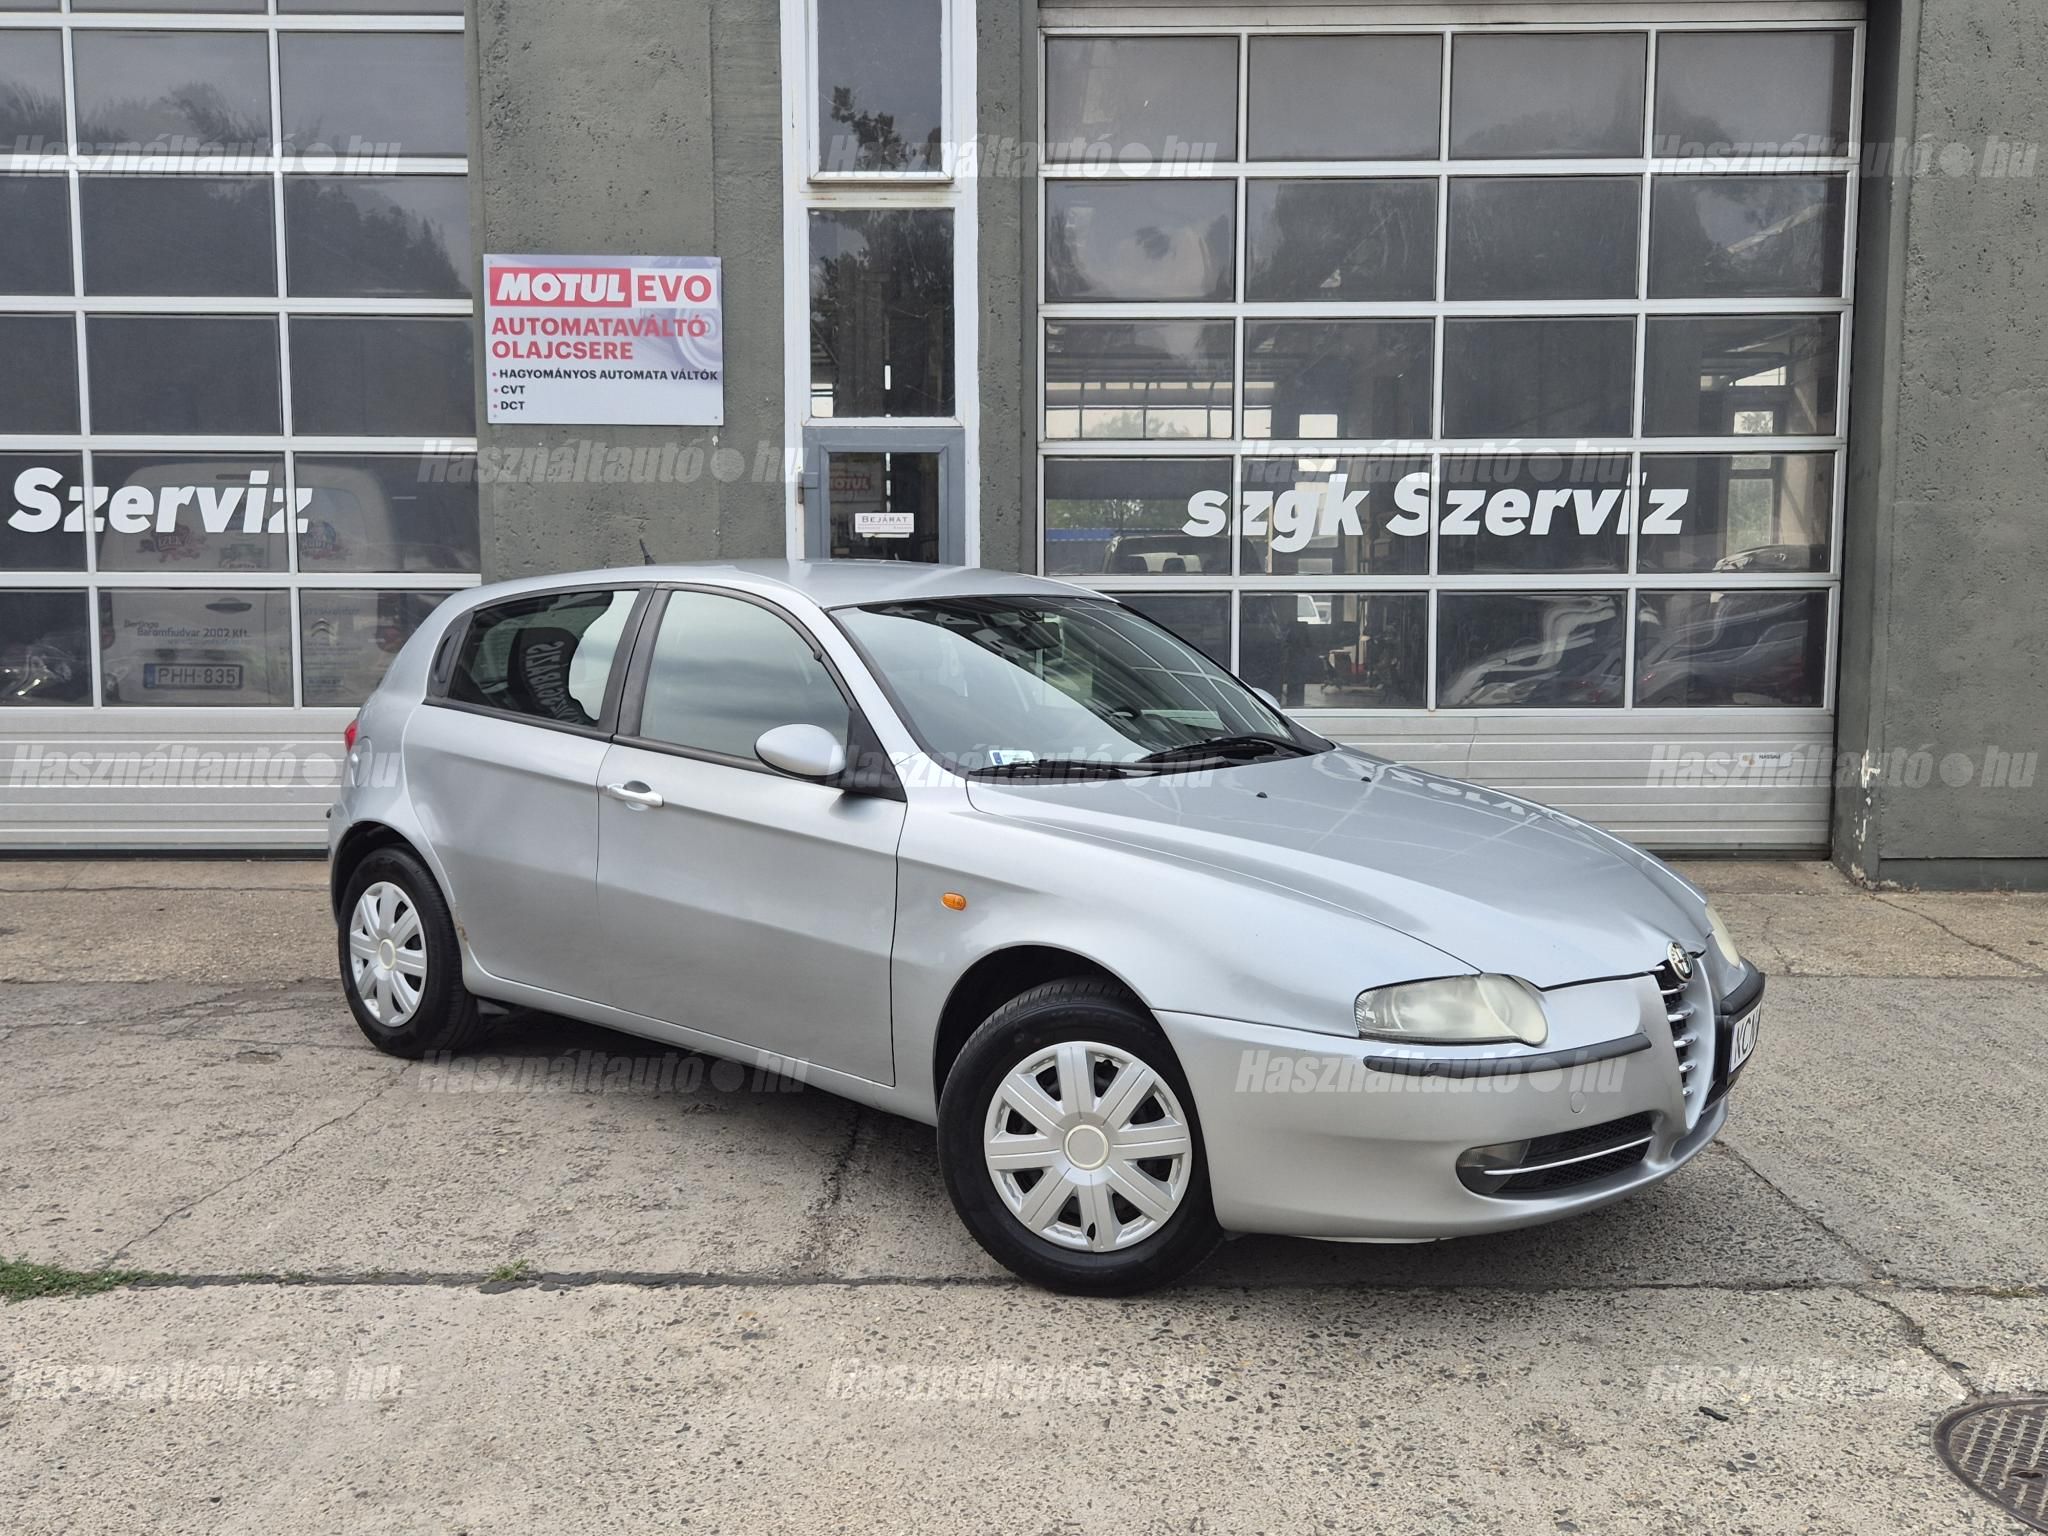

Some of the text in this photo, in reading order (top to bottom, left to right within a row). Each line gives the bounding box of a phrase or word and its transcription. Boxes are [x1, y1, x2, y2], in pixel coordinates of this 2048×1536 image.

[497, 272, 712, 303] MOTUL EVO
[492, 314, 706, 337] AUTOMATAVÁLTÓ
[492, 340, 633, 360] OLAJCSERE
[499, 367, 718, 381] HAGYOMÁNYOS AUTOMATA VÁLTÓK
[500, 385, 526, 396] CVT
[500, 400, 526, 411] DCT
[8, 467, 313, 533] Szerviz
[1182, 472, 1688, 553] szgk Szerviz
[158, 668, 236, 685] PHH-835
